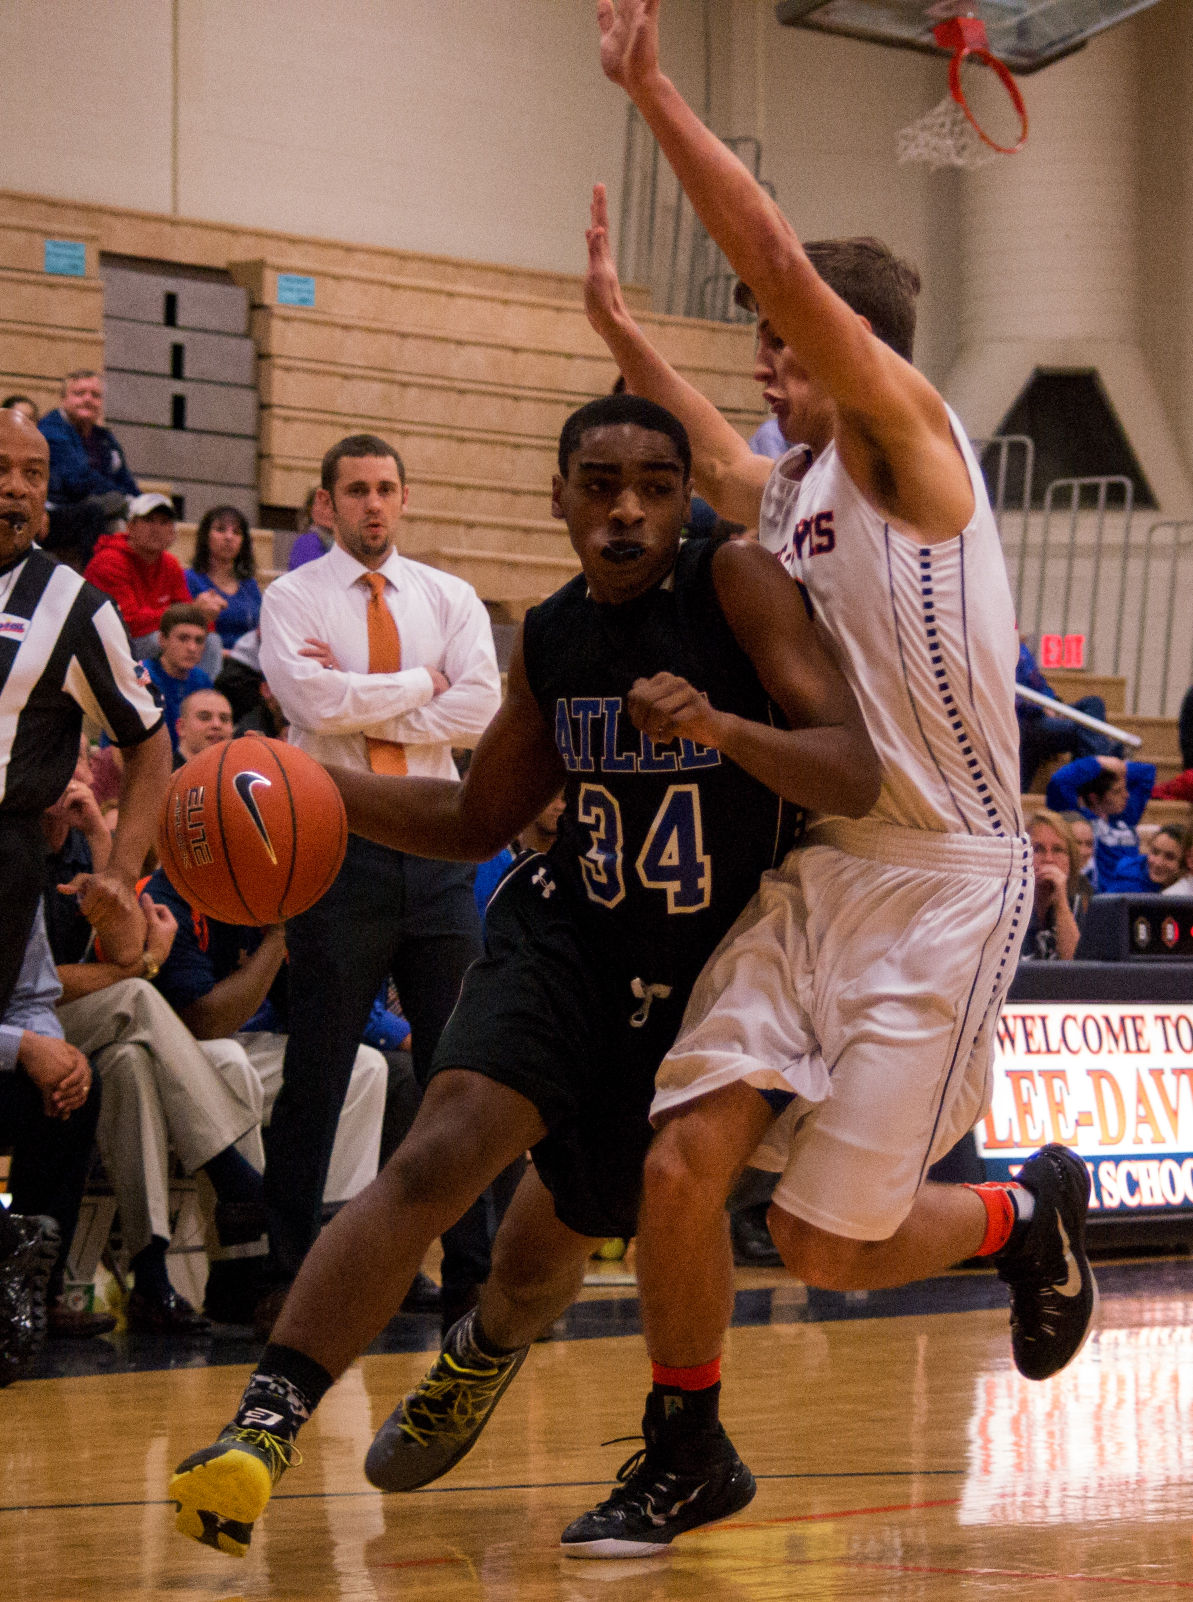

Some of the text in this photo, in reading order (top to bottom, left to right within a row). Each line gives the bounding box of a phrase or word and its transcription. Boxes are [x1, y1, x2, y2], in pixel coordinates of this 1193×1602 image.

[187, 785, 214, 866] ELITE
[578, 782, 712, 915] 34
[996, 1013, 1193, 1056] WELCOME TO
